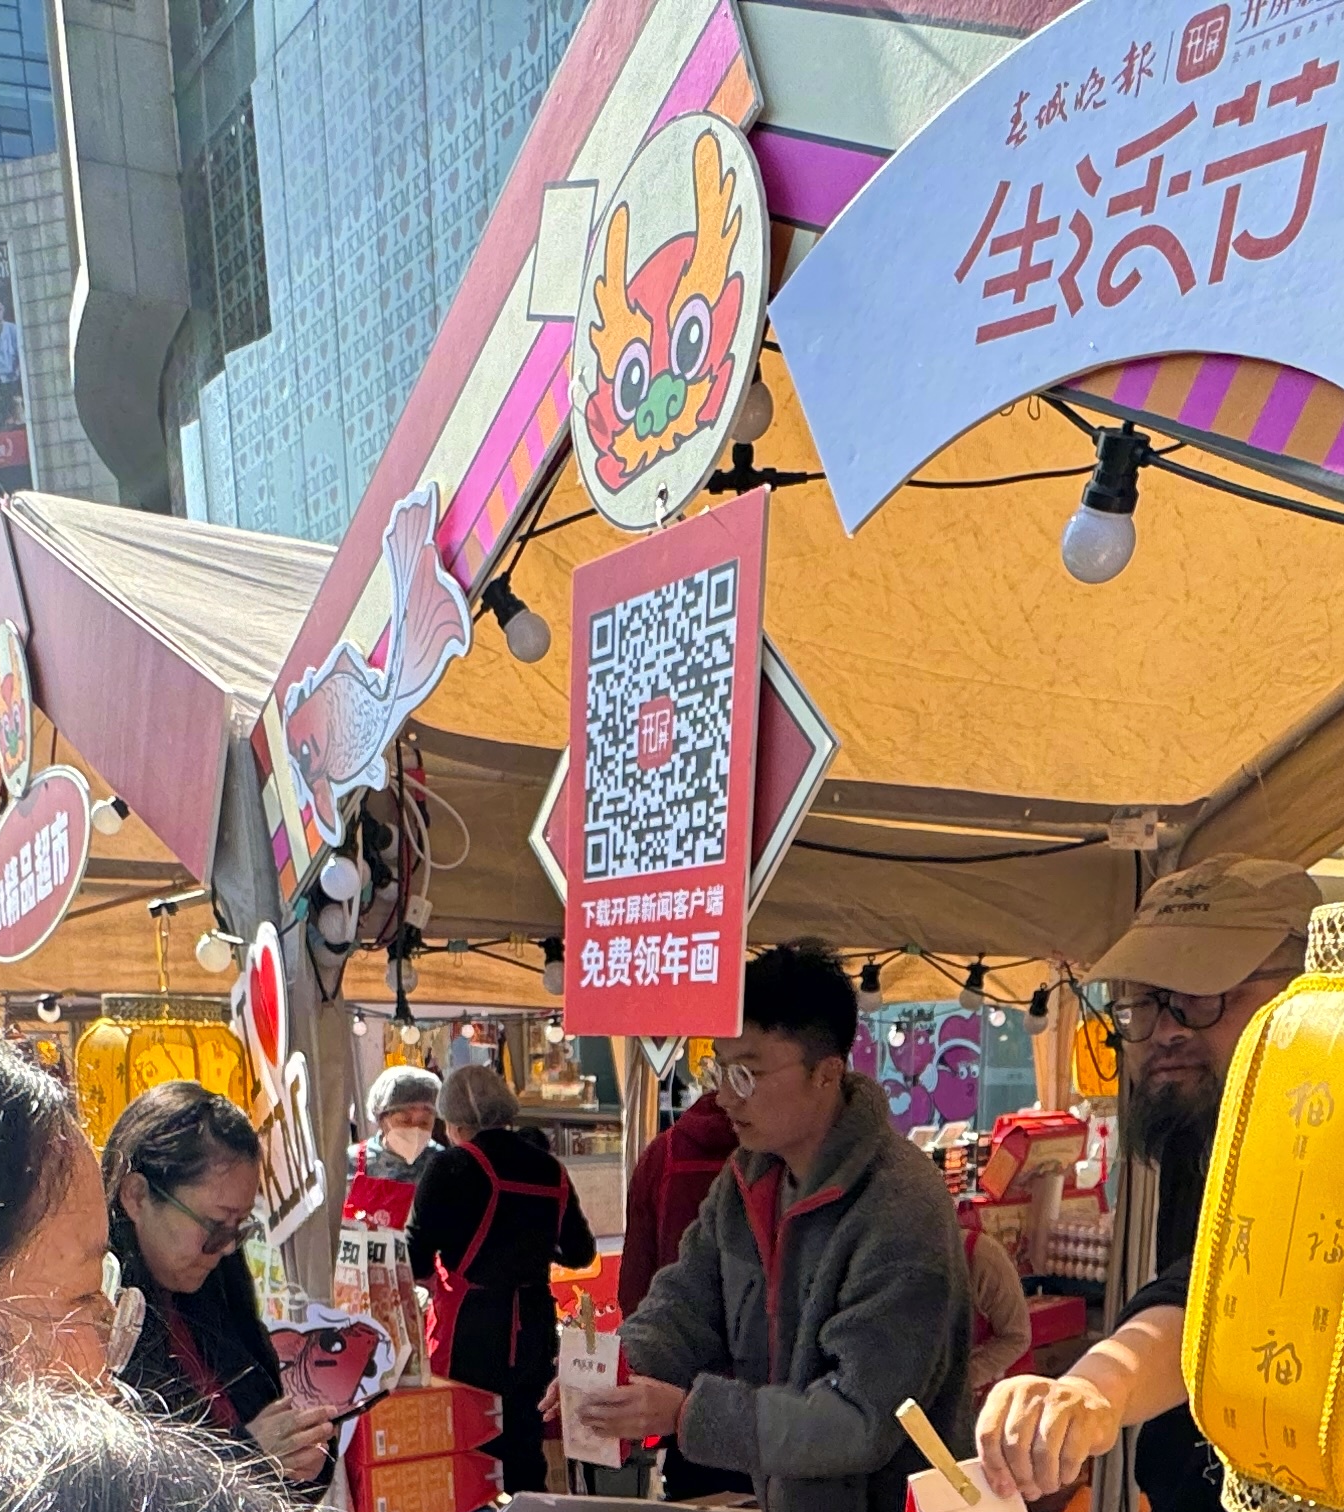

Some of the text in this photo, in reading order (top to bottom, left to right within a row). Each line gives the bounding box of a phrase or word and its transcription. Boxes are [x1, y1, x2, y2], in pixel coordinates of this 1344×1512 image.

[954, 57, 1341, 345] 生活节
[581, 884, 725, 930] 下载开屏新闻客户端
[579, 930, 720, 989] 免费领年画
